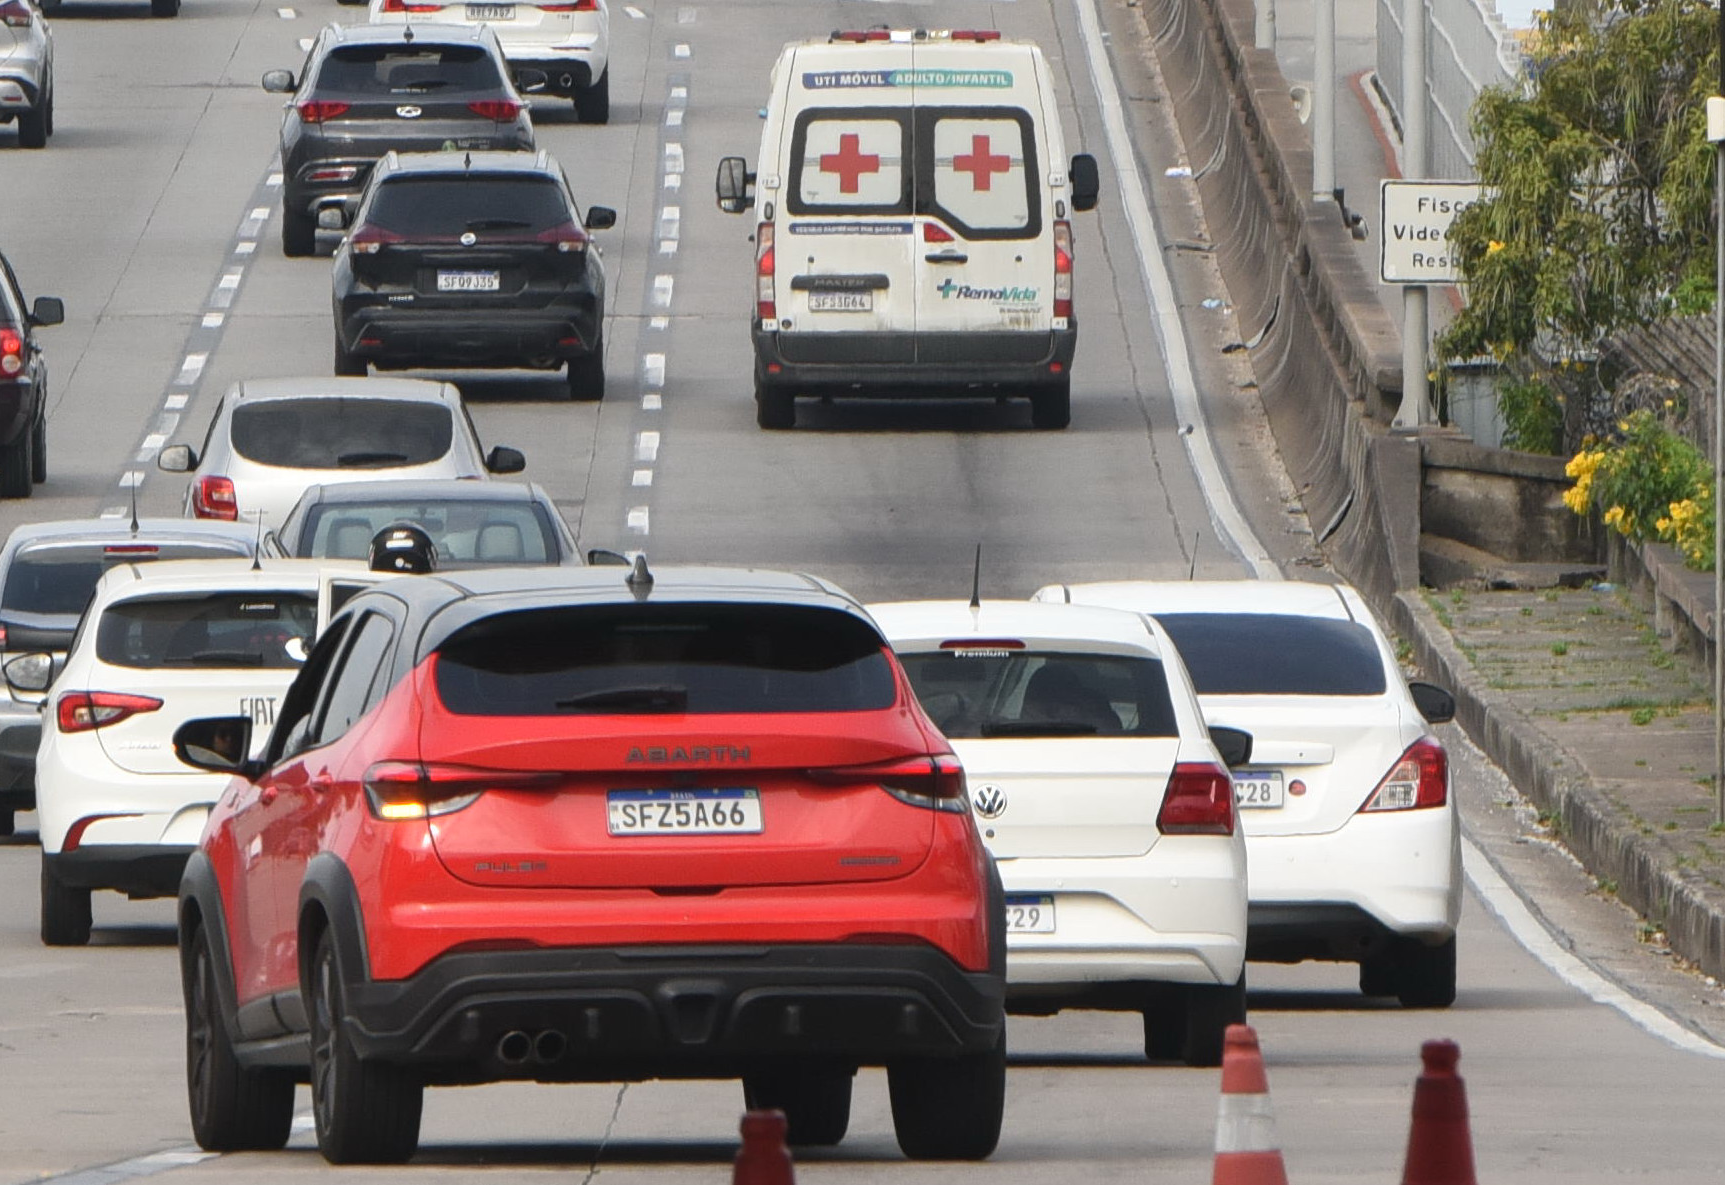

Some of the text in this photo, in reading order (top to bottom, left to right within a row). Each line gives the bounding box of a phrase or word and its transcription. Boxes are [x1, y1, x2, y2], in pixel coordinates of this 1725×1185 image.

[814, 72, 1009, 86] UTI MÓVEL ADULTO/INFANTIL
[1393, 225, 1450, 241] Vide
[954, 649, 1010, 659] Premium
[240, 697, 277, 726] FIAT
[625, 746, 751, 764] ABARTH
[622, 801, 745, 828] SFZ5A66
